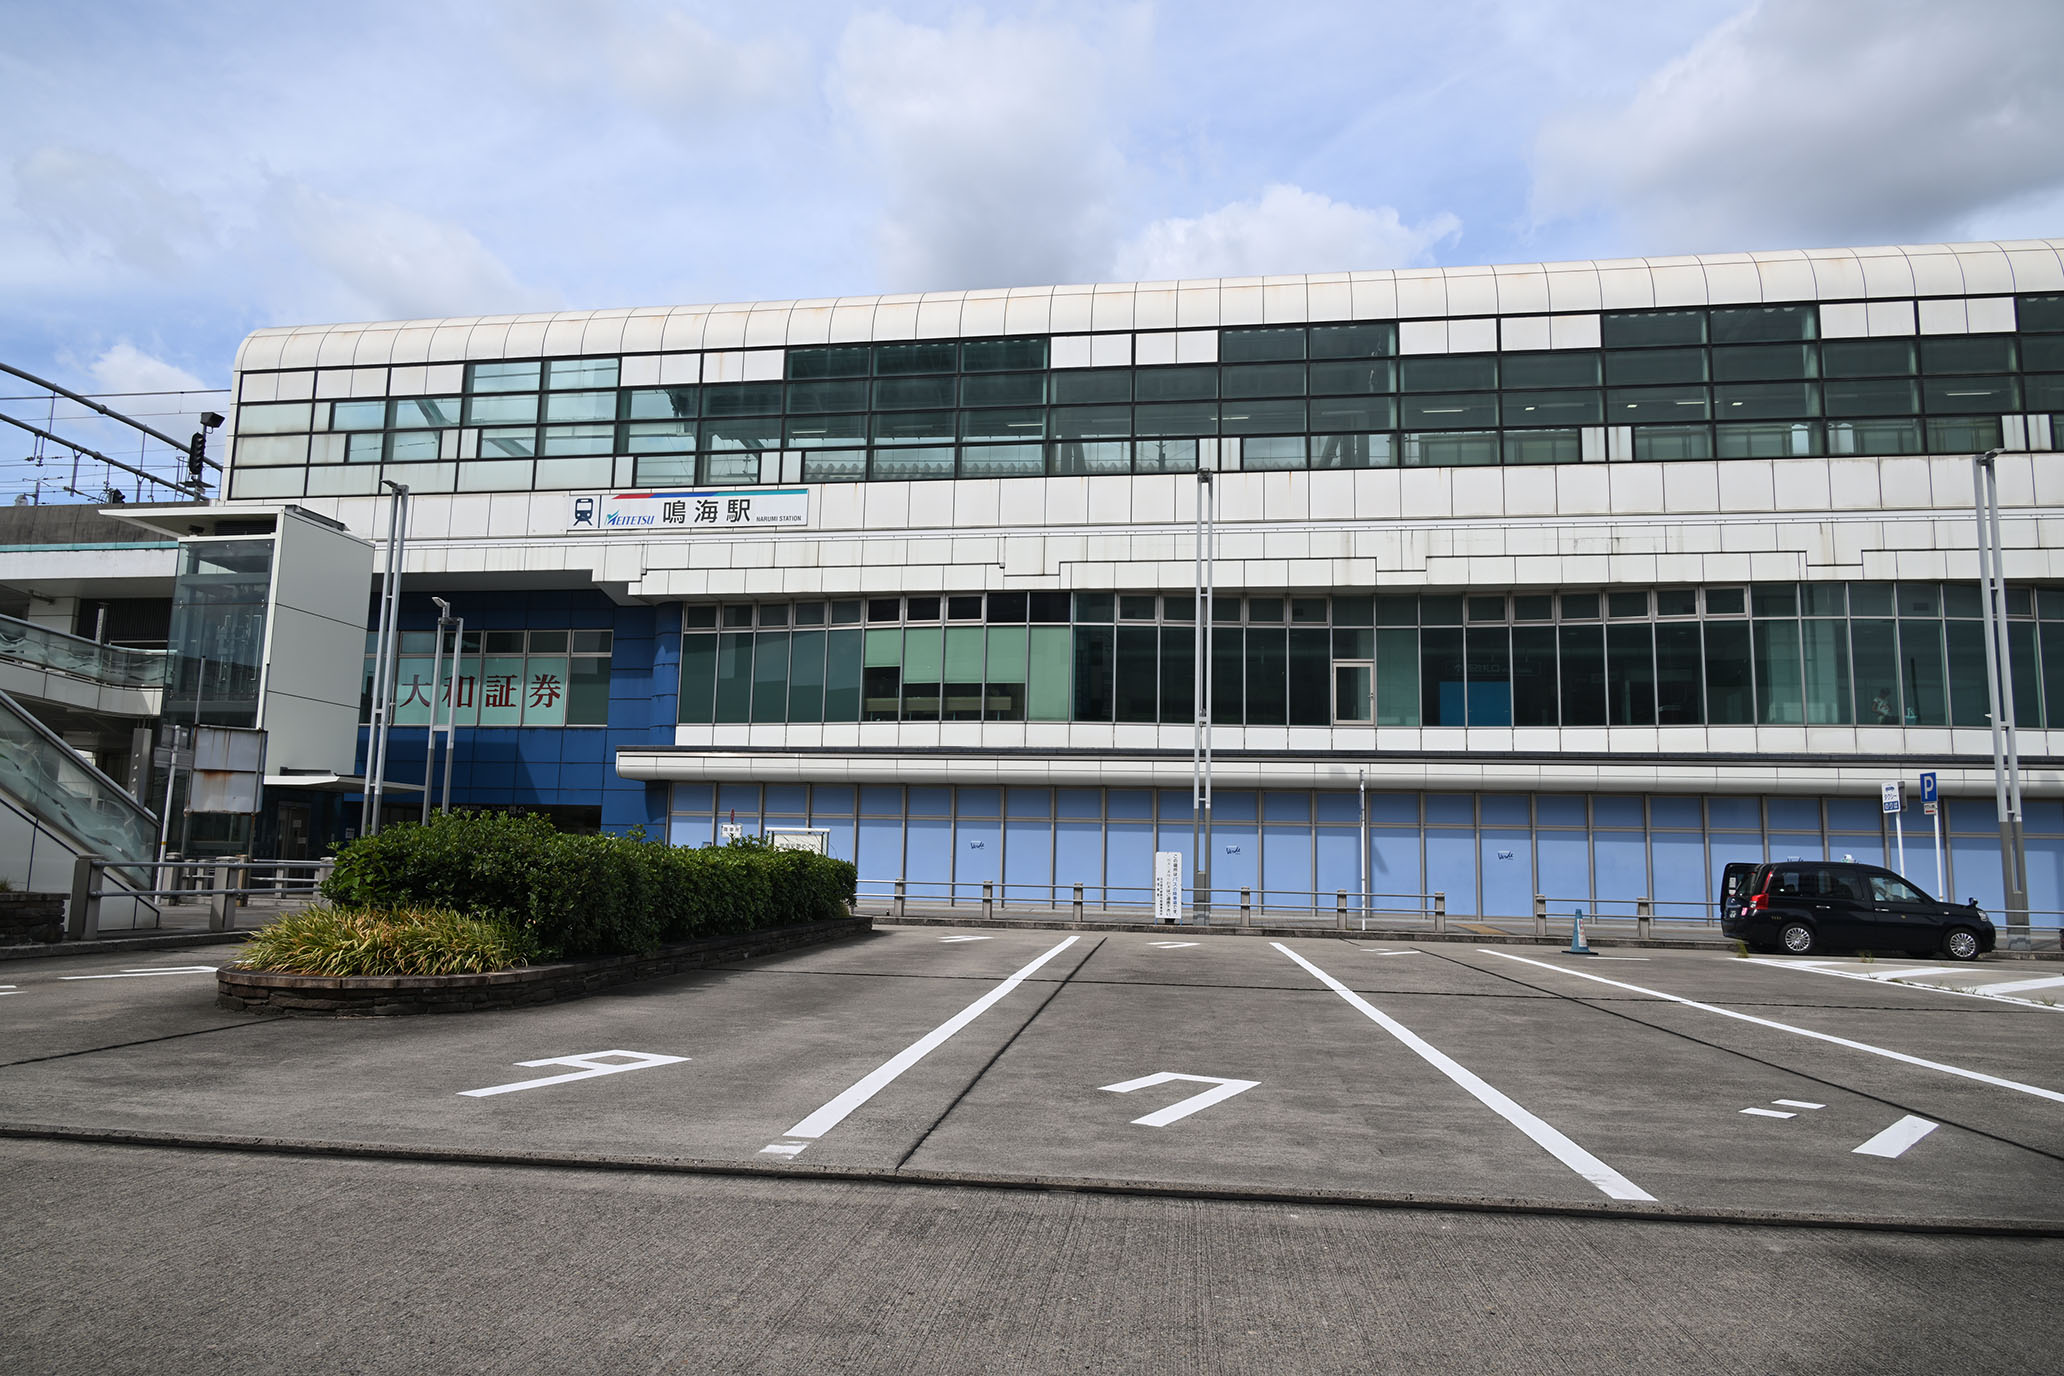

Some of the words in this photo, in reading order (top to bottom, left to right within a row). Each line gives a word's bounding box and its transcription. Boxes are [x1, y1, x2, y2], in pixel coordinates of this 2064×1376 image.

[662, 499, 750, 524] 鳴海駅
[399, 673, 562, 708] 大和証券
[1923, 775, 1934, 800] P
